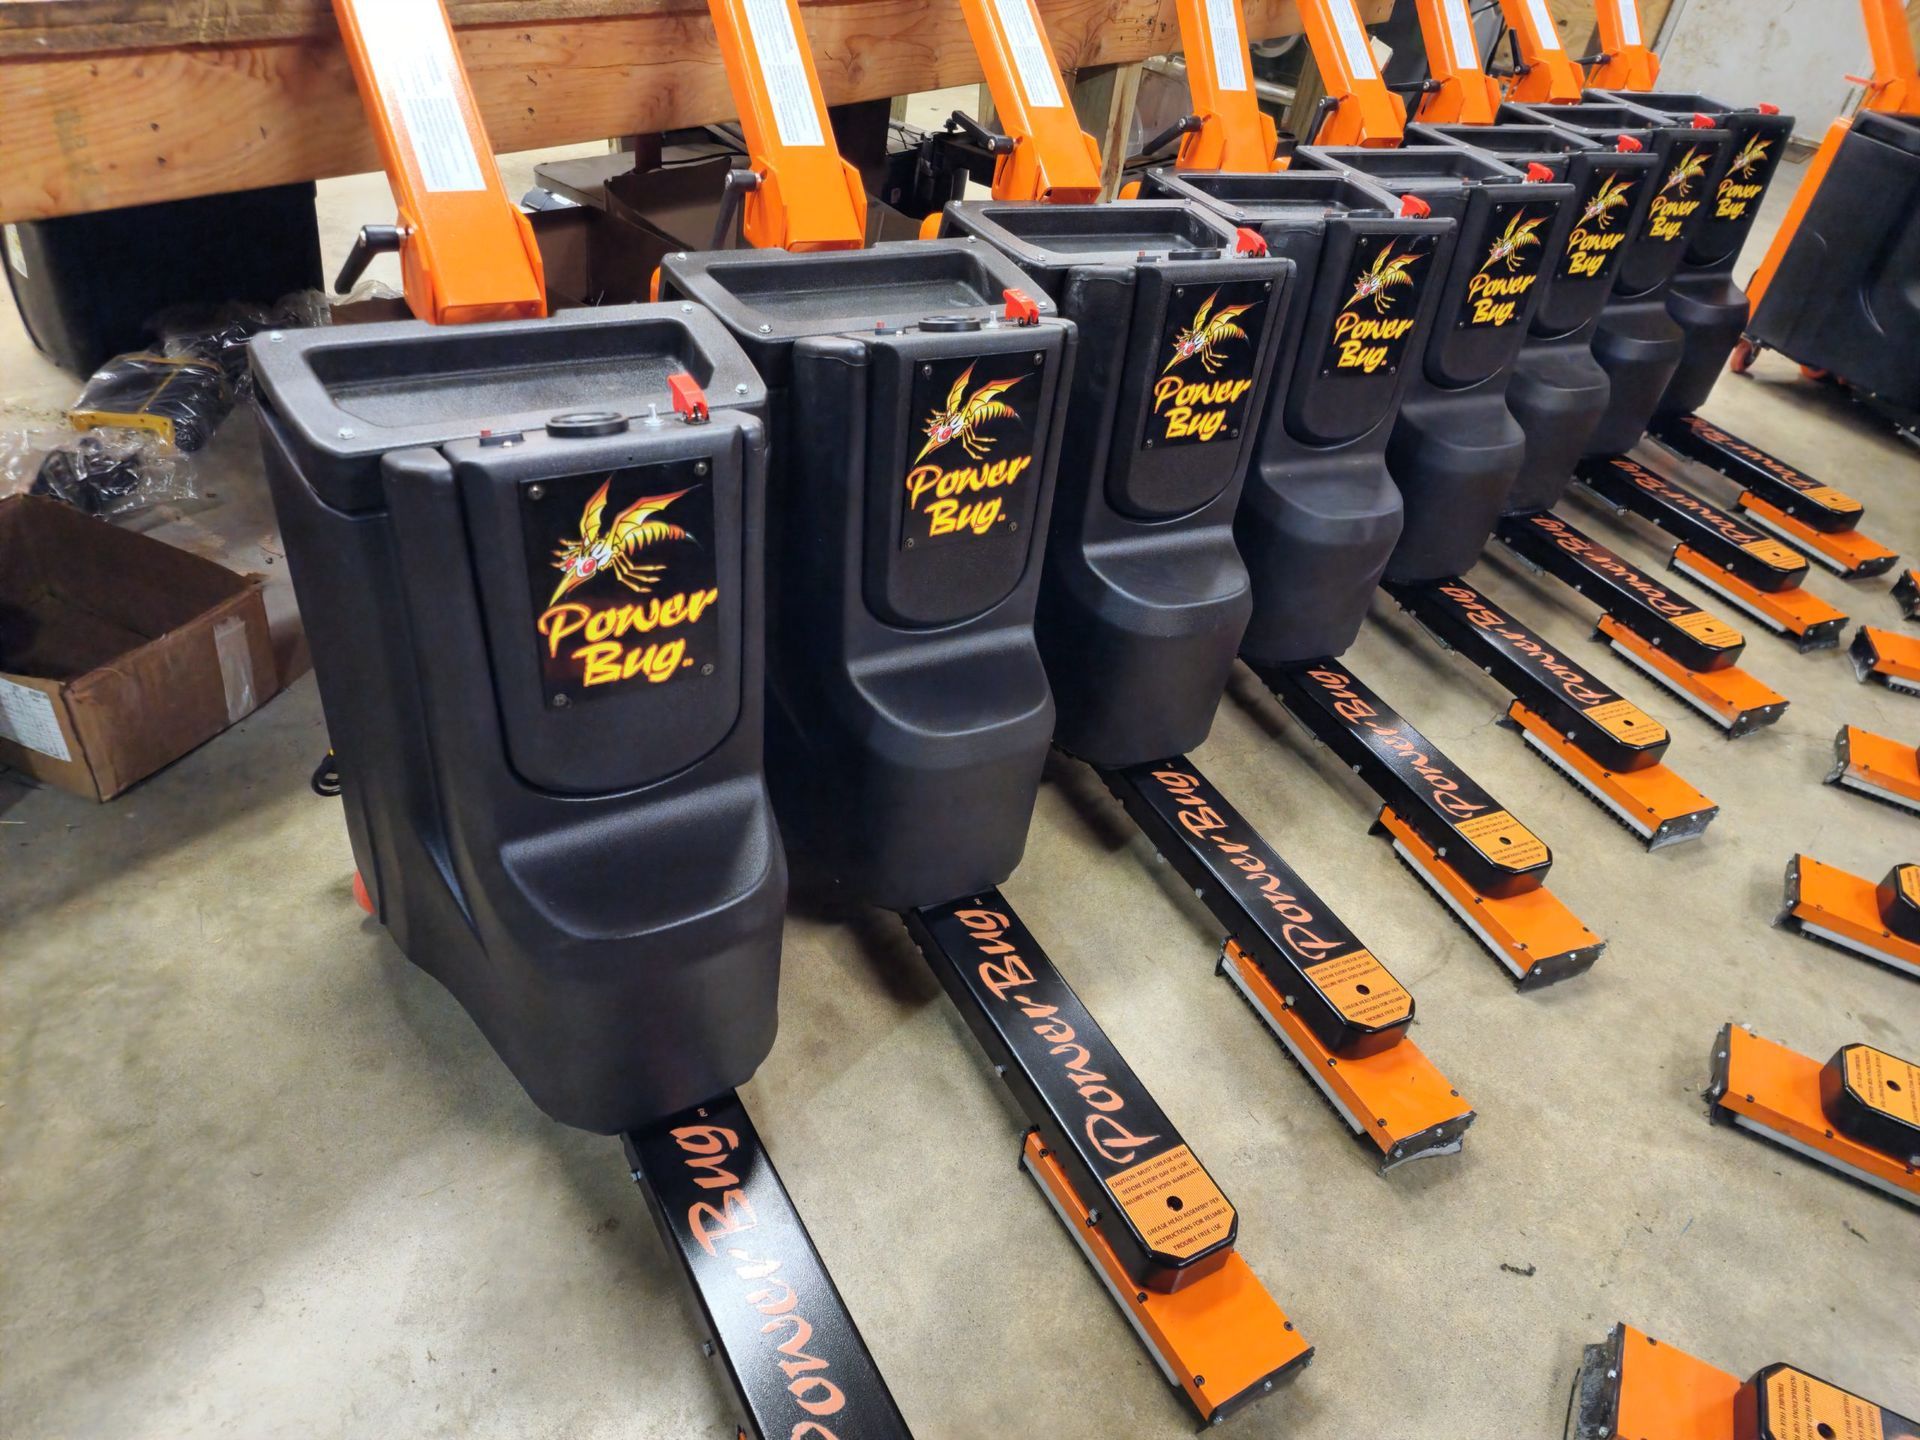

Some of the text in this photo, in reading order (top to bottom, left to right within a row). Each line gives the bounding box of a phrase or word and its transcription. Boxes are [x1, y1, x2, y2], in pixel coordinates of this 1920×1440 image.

[1716, 179, 1763, 200] Power
[1648, 196, 1700, 220] Power
[1566, 229, 1625, 255] Power
[1467, 273, 1536, 303] Power
[1332, 312, 1414, 345] Power
[1154, 376, 1252, 414] Power
[906, 455, 1032, 510] Power
[537, 587, 718, 658] Power
[1154, 1224, 1193, 1246] INSTRUCTIONS
